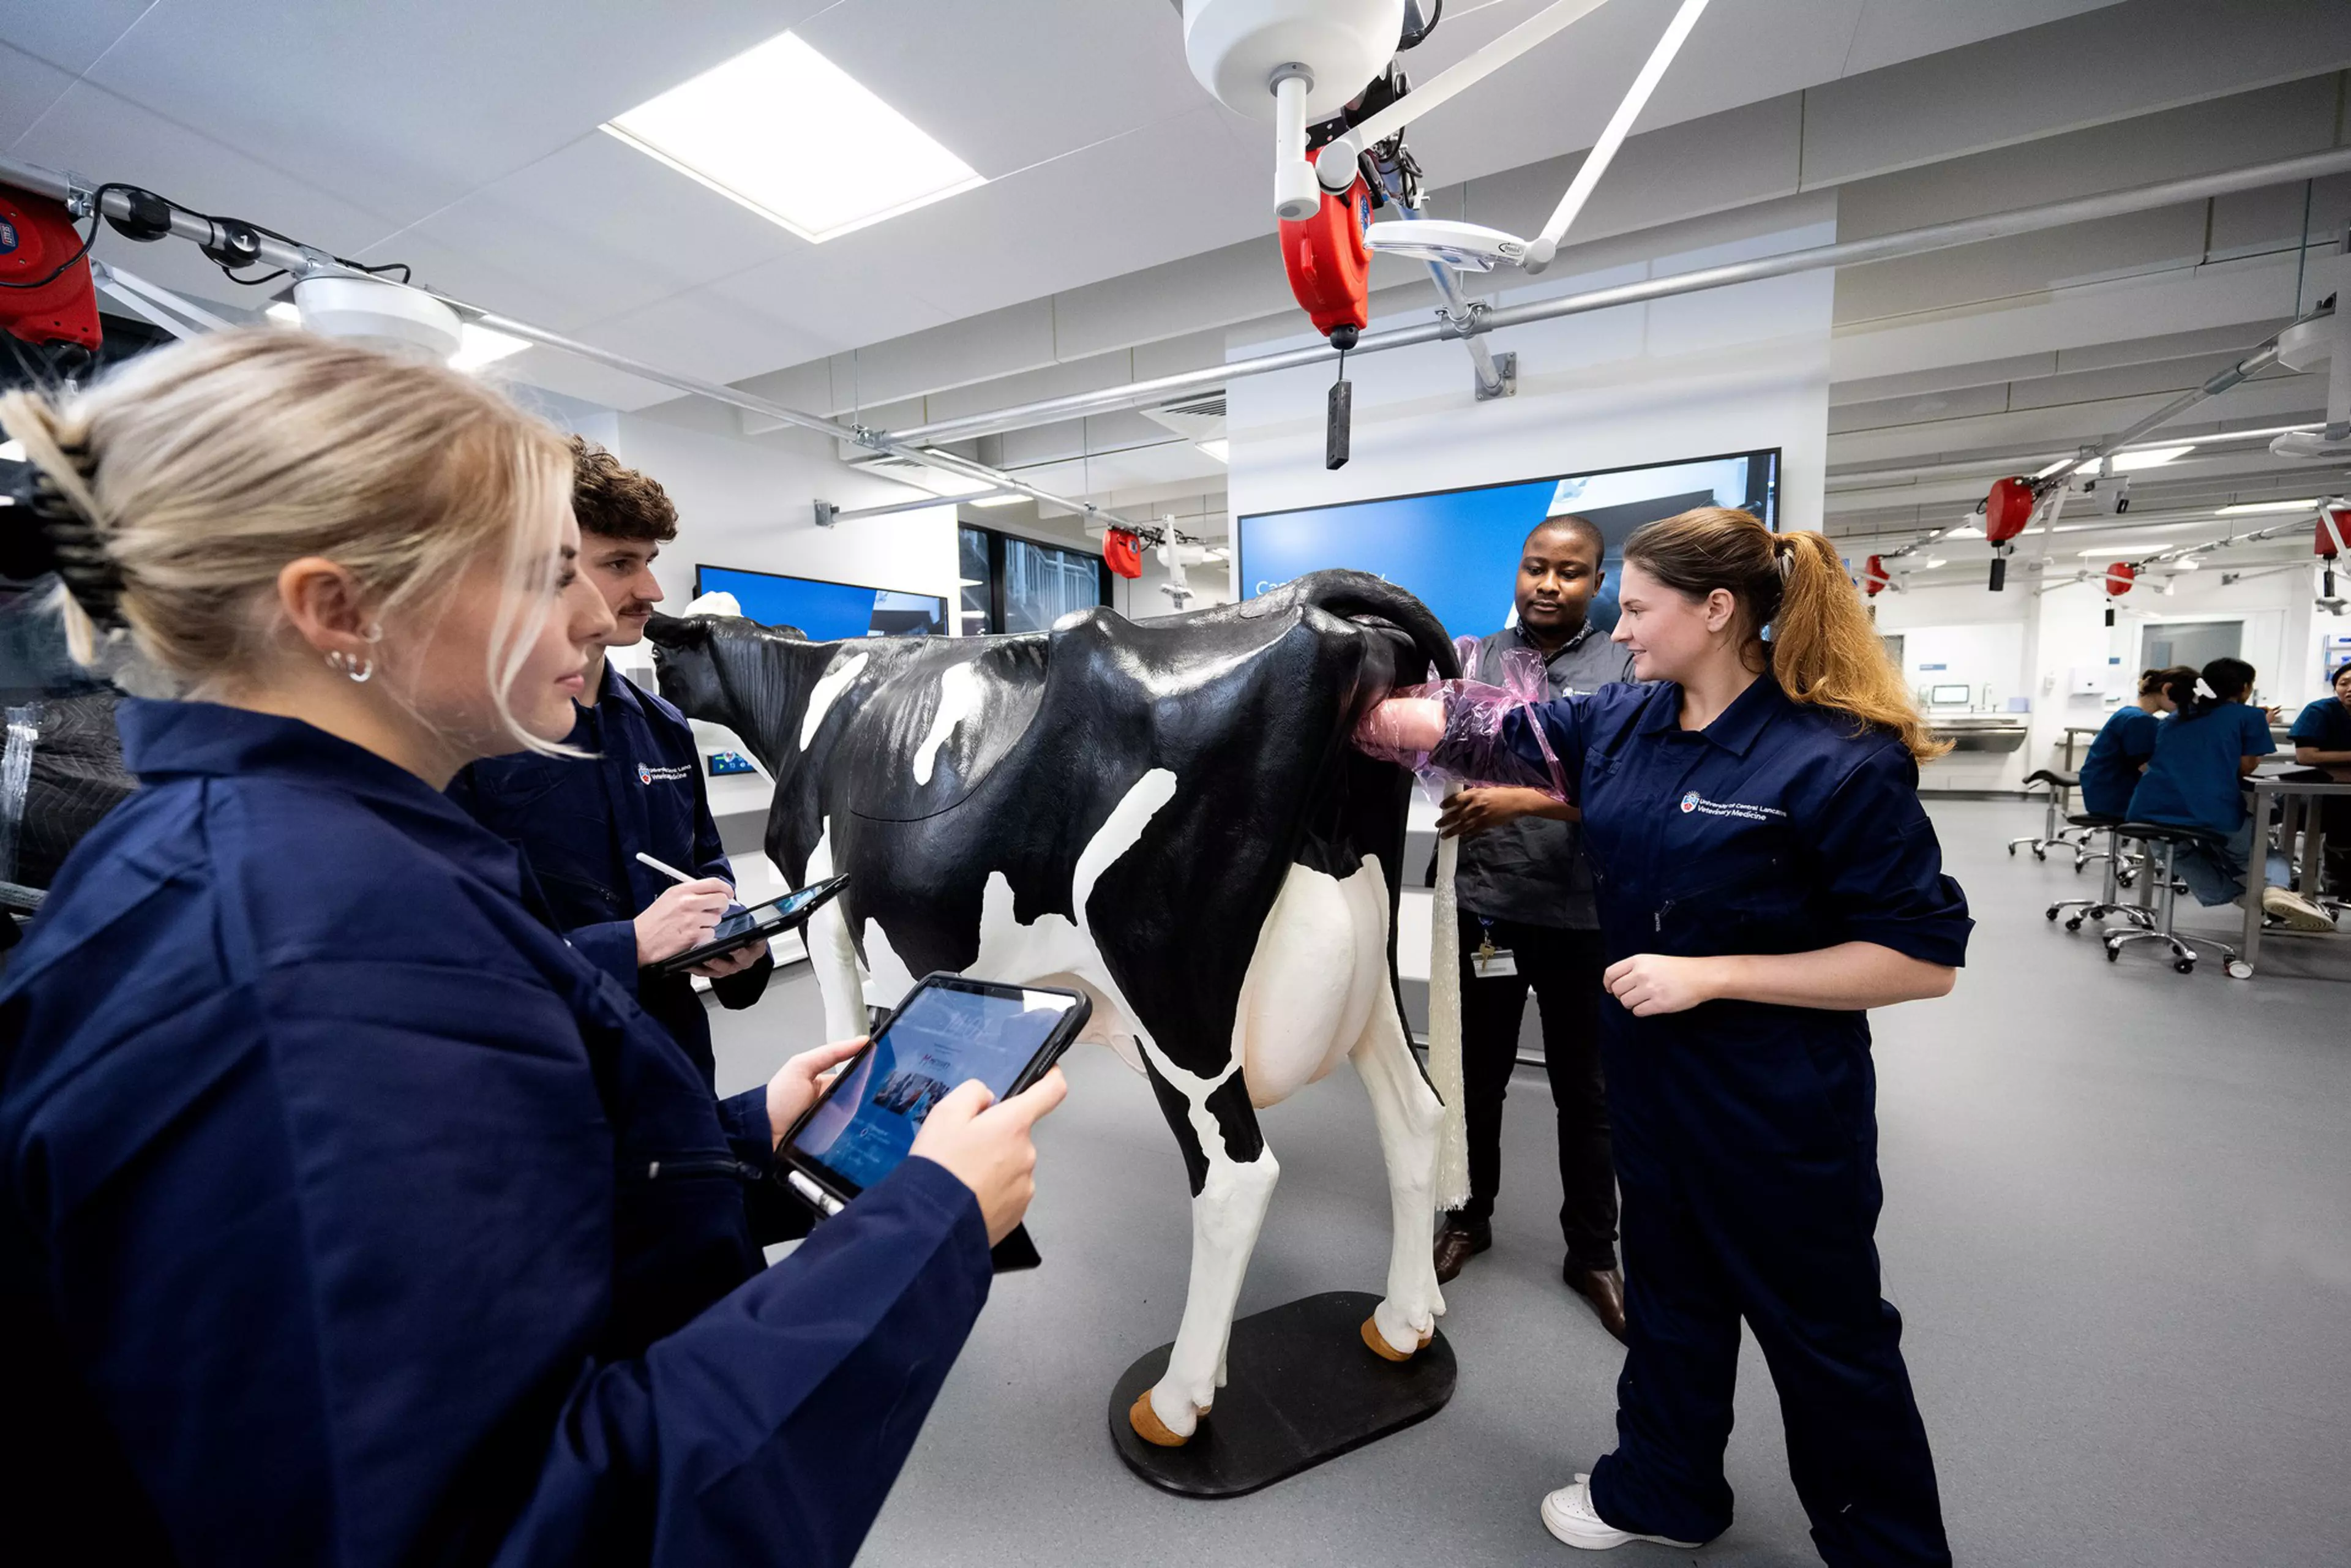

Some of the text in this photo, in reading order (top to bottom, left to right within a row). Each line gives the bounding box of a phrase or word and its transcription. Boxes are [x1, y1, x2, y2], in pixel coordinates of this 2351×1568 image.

[240, 234, 248, 247] 1
[1697, 805, 1767, 821] Veterinary Medicine
